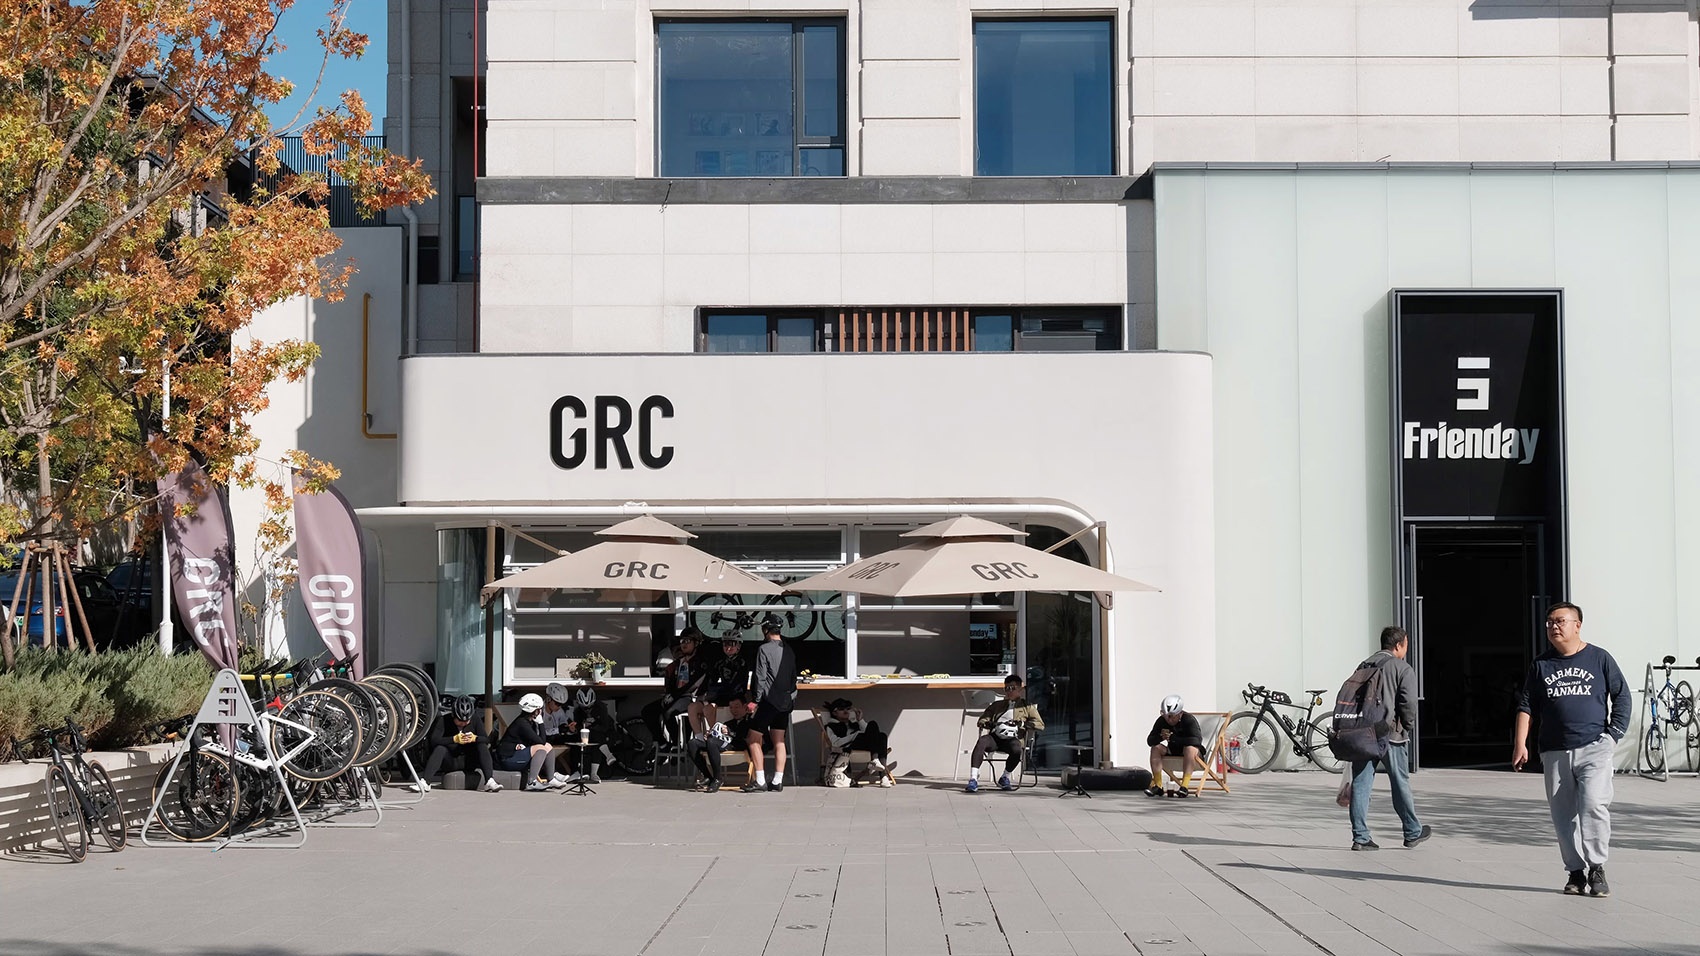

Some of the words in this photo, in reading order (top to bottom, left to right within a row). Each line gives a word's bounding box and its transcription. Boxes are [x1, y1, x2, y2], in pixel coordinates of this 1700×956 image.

[550, 395, 675, 470] GRC
[1403, 421, 1541, 465] Frienday
[603, 560, 670, 580] GRC
[848, 561, 901, 581] GRC
[970, 561, 1039, 581] GRC
[308, 574, 357, 651] GRC
[1544, 667, 1595, 685] GARMENT
[1547, 685, 1592, 698] PANMAX
